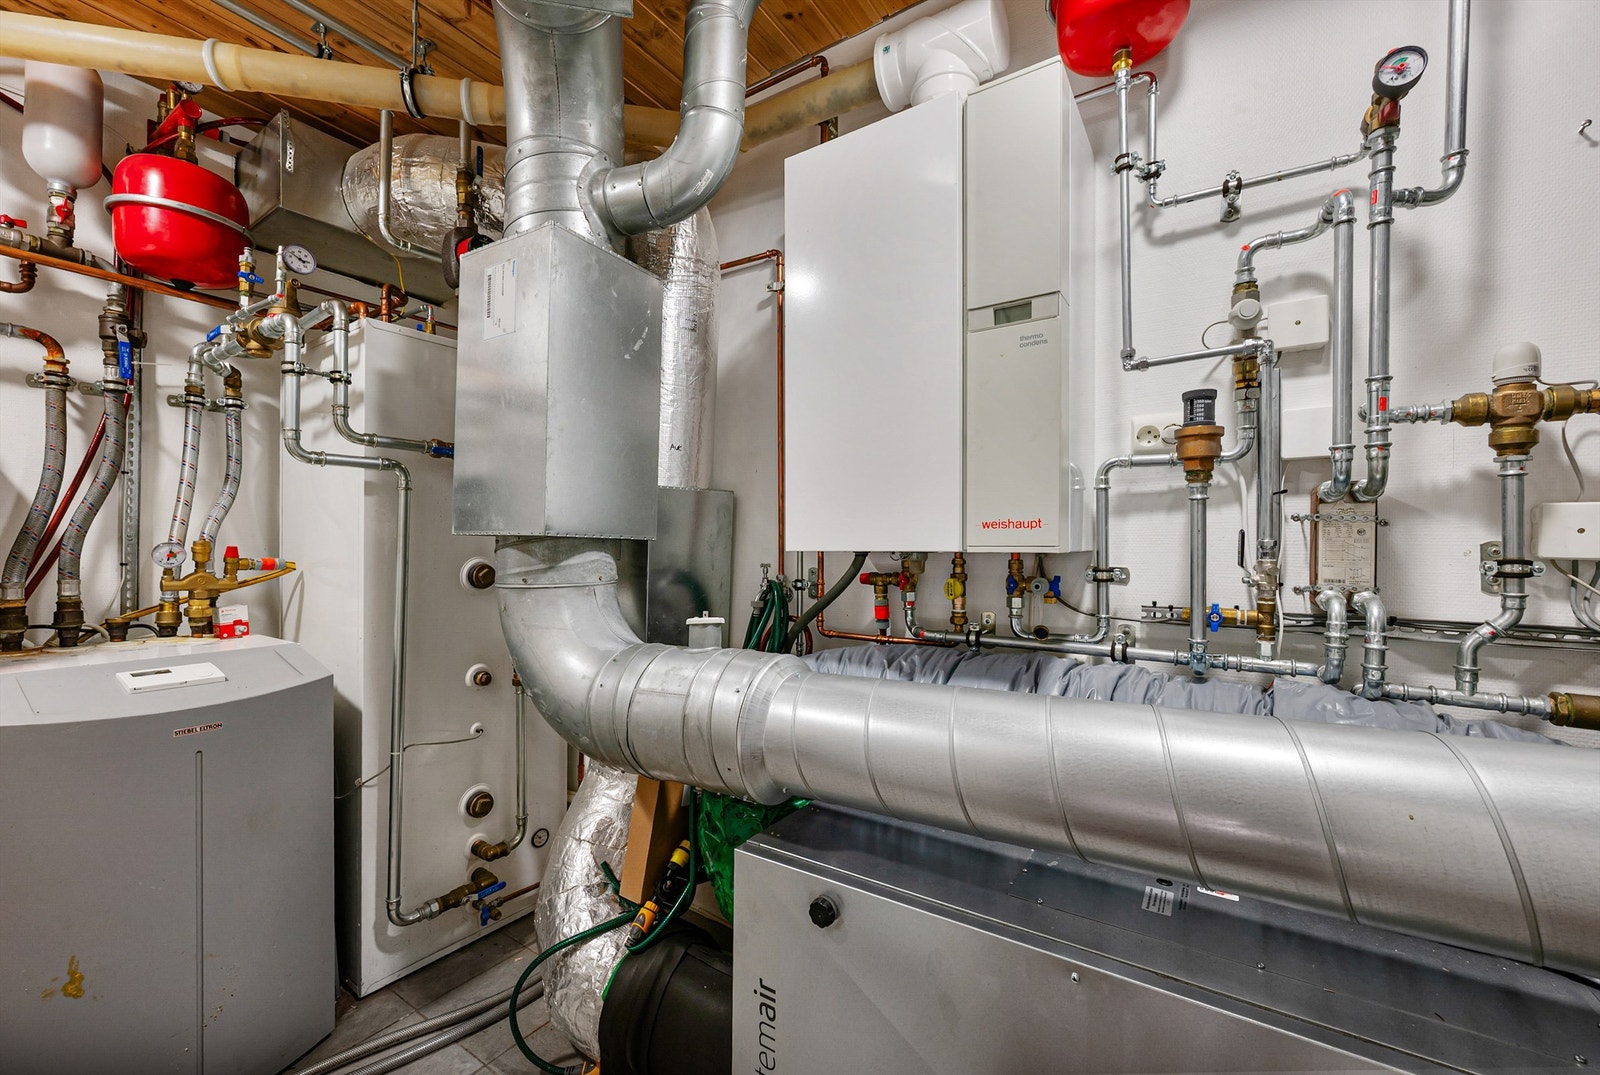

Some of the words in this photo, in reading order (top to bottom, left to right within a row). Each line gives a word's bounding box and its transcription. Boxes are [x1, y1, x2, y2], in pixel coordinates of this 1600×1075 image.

[1019, 333, 1044, 342] thermo
[1019, 338, 1048, 348] condens
[981, 518, 1042, 530] weishaupt
[174, 728, 198, 737] STIEBEL
[199, 723, 223, 732] ELTRON
